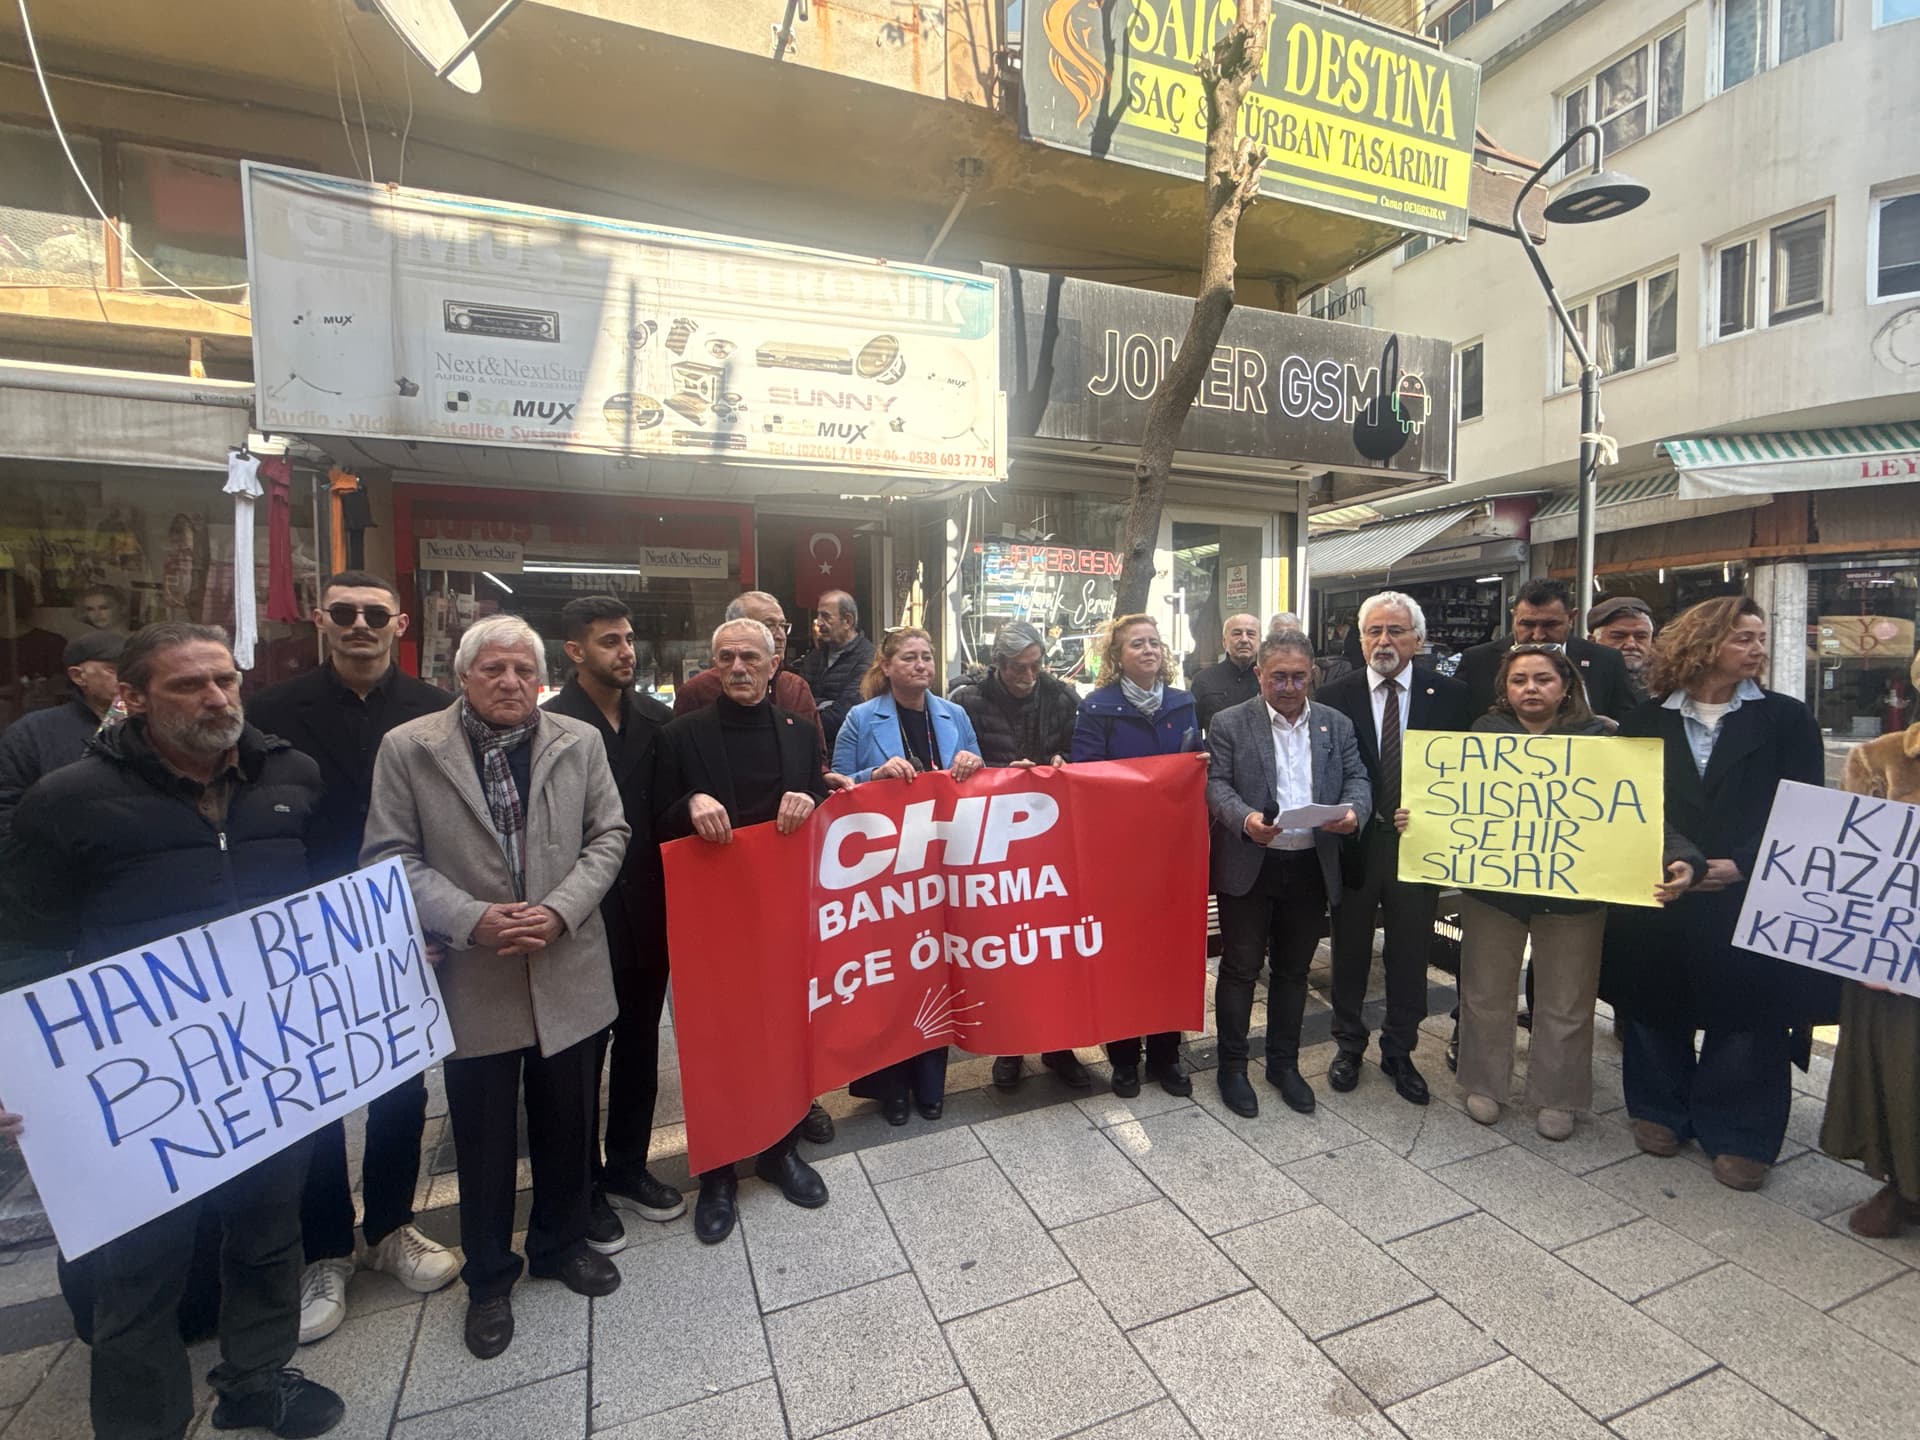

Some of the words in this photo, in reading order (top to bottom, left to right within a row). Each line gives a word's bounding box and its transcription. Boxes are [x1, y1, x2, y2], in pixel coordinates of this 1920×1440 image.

[1286, 23, 1457, 141] DESTİNA
[1128, 71, 1186, 135] SAÇ
[1339, 131, 1448, 192] TASARIMI
[767, 386, 899, 412] SUNNY
[1280, 355, 1380, 427] GSM
[940, 453, 961, 466] 603
[964, 454, 977, 467] 77
[999, 544, 1076, 573] JOKER
[1078, 549, 1126, 575] GSM
[1425, 736, 1573, 778] ÇARŞI
[1425, 777, 1647, 824] SUSARSA
[819, 792, 1060, 890] CHP
[1421, 852, 1579, 894] SUSAR
[1761, 839, 1920, 909] KAZA
[819, 865, 1068, 941] BANDIRMA
[1784, 891, 1920, 946] SER
[23, 925, 233, 1069] HANİ
[249, 865, 414, 990] BENİM
[809, 949, 895, 1024] LÇE
[910, 915, 1103, 970] ÖRGÜTÜ
[87, 938, 431, 1147] BAKKALIM
[150, 997, 440, 1194] NEREDE?
